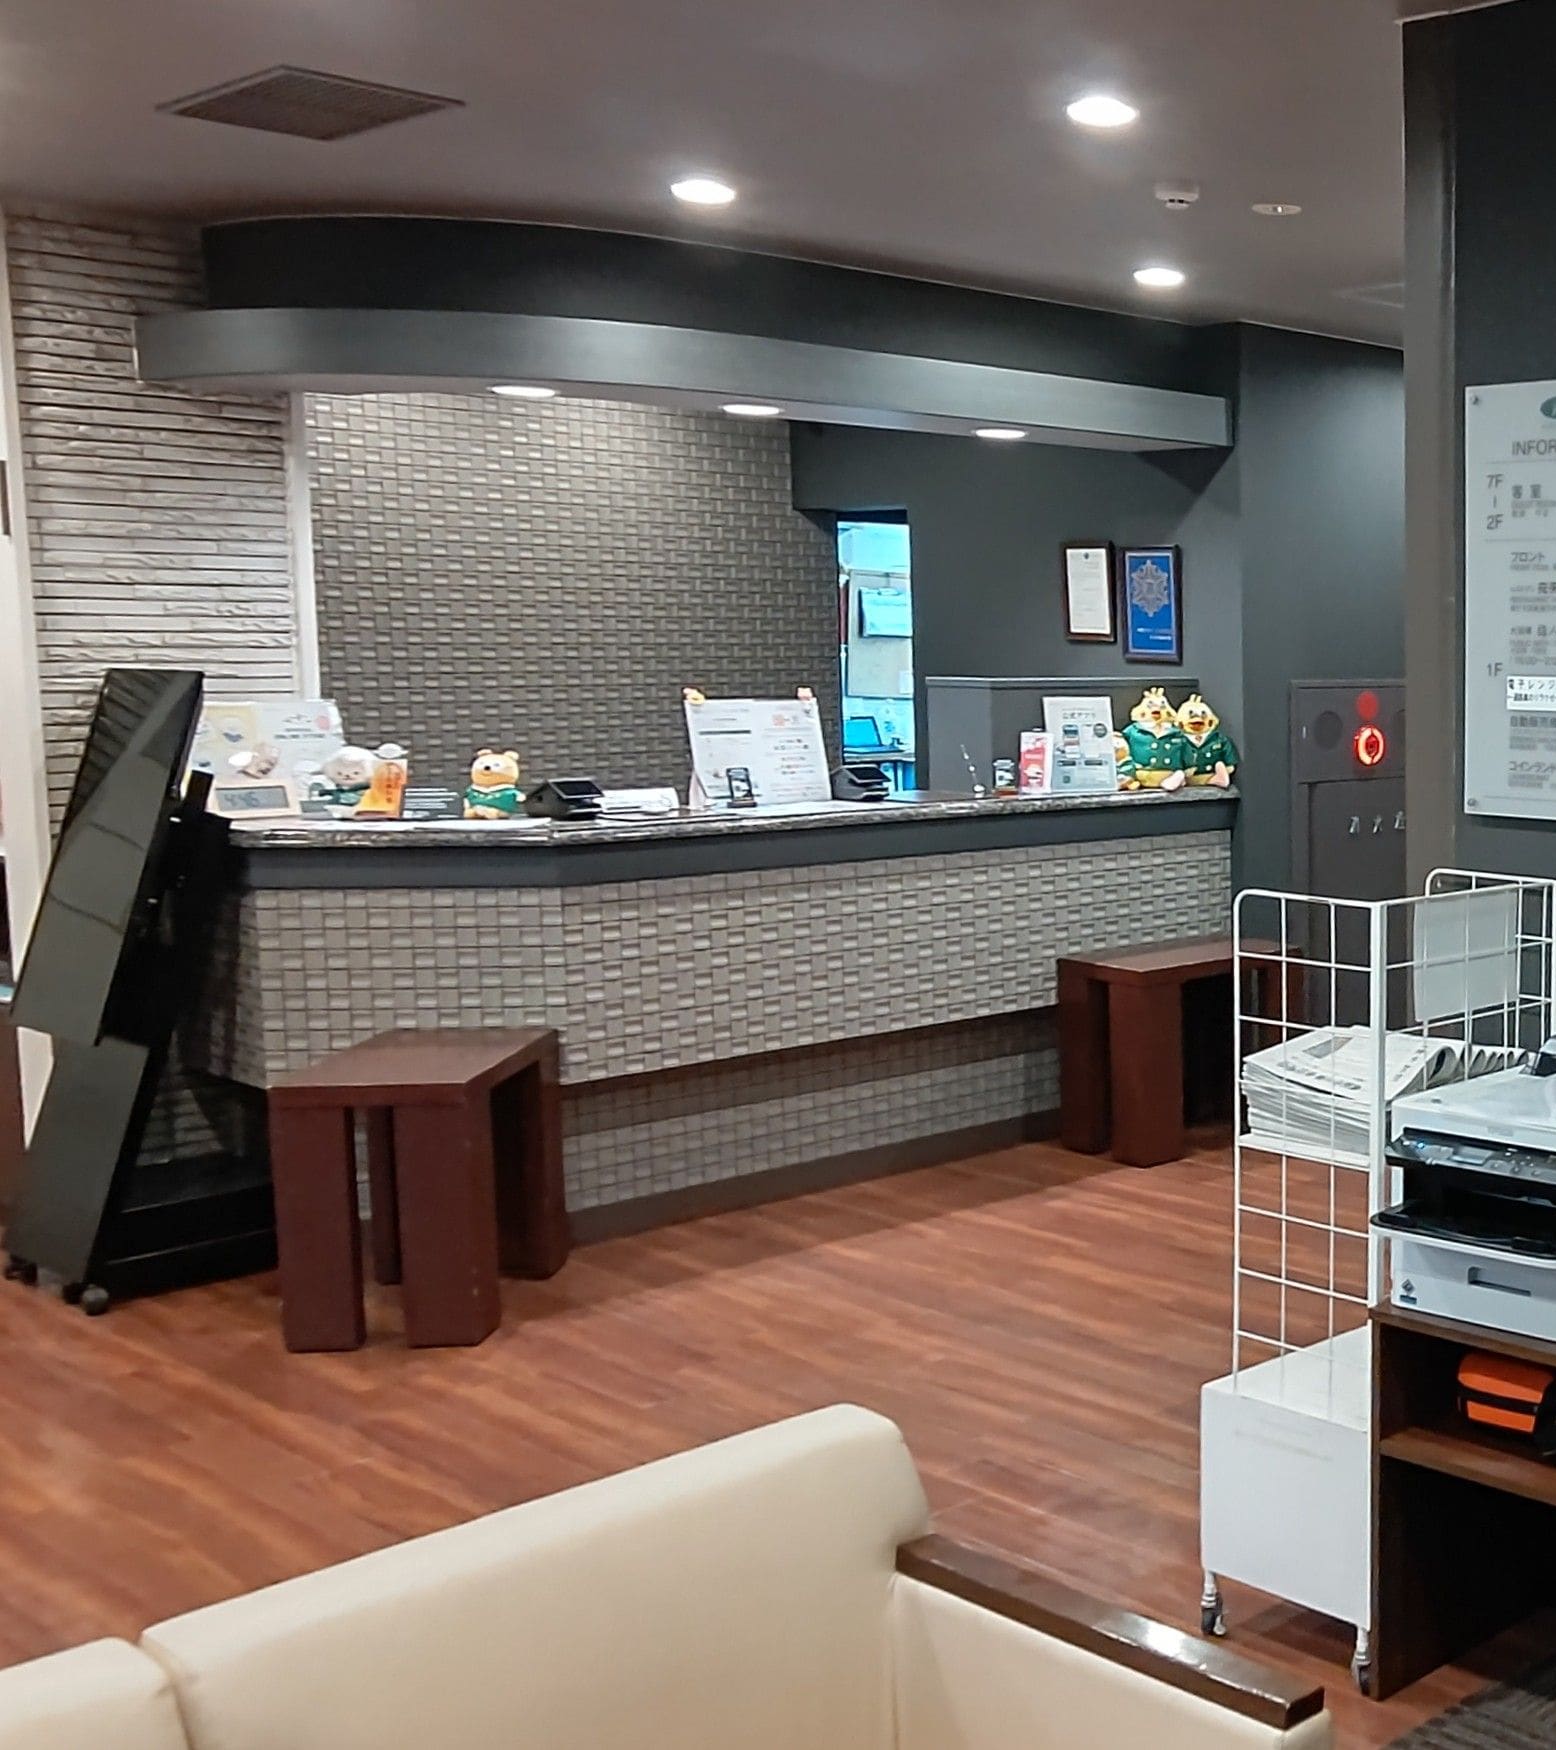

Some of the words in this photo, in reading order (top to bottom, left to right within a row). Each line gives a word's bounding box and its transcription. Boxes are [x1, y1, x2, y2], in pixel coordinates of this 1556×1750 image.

[1486, 474, 1503, 488] 7F
[1487, 514, 1503, 529] 2F
[1510, 552, 1544, 562] フロント
[1487, 662, 1503, 676] 1F
